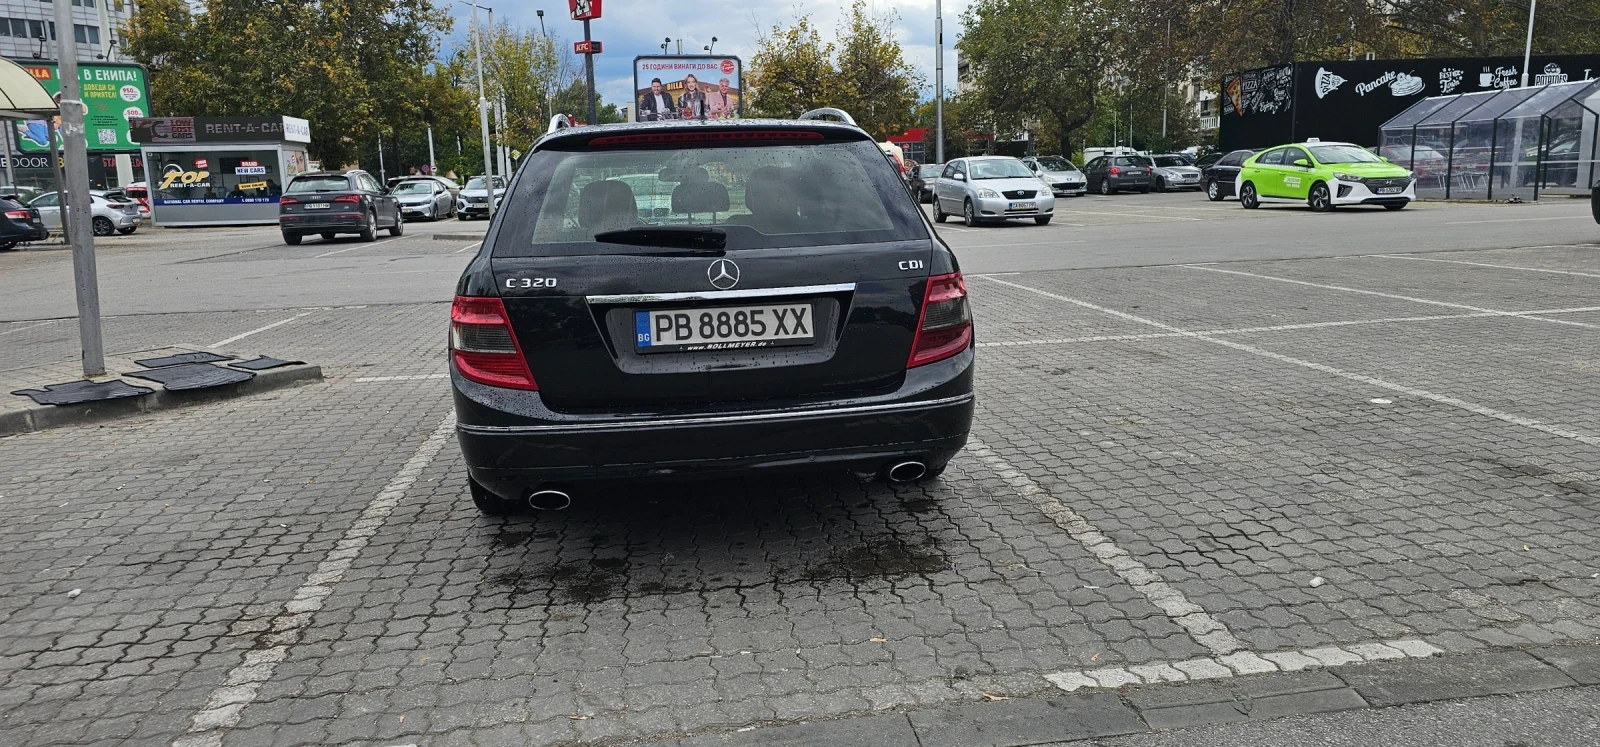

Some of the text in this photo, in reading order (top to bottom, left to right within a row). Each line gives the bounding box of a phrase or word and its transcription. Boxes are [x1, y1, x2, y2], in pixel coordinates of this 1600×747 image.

[576, 43, 588, 51] KFC
[84, 69, 92, 80] В
[95, 70, 138, 81] ЕКИПА!
[1495, 66, 1518, 77] Fresh
[667, 81, 683, 90] BILLA
[1355, 71, 1397, 96] Pancake
[1494, 76, 1518, 89] Coffee
[159, 171, 210, 190] TOP
[898, 260, 924, 270] CDI
[506, 278, 557, 288] C 320
[655, 307, 809, 342] PB 8885 XX
[637, 333, 650, 342] BG
